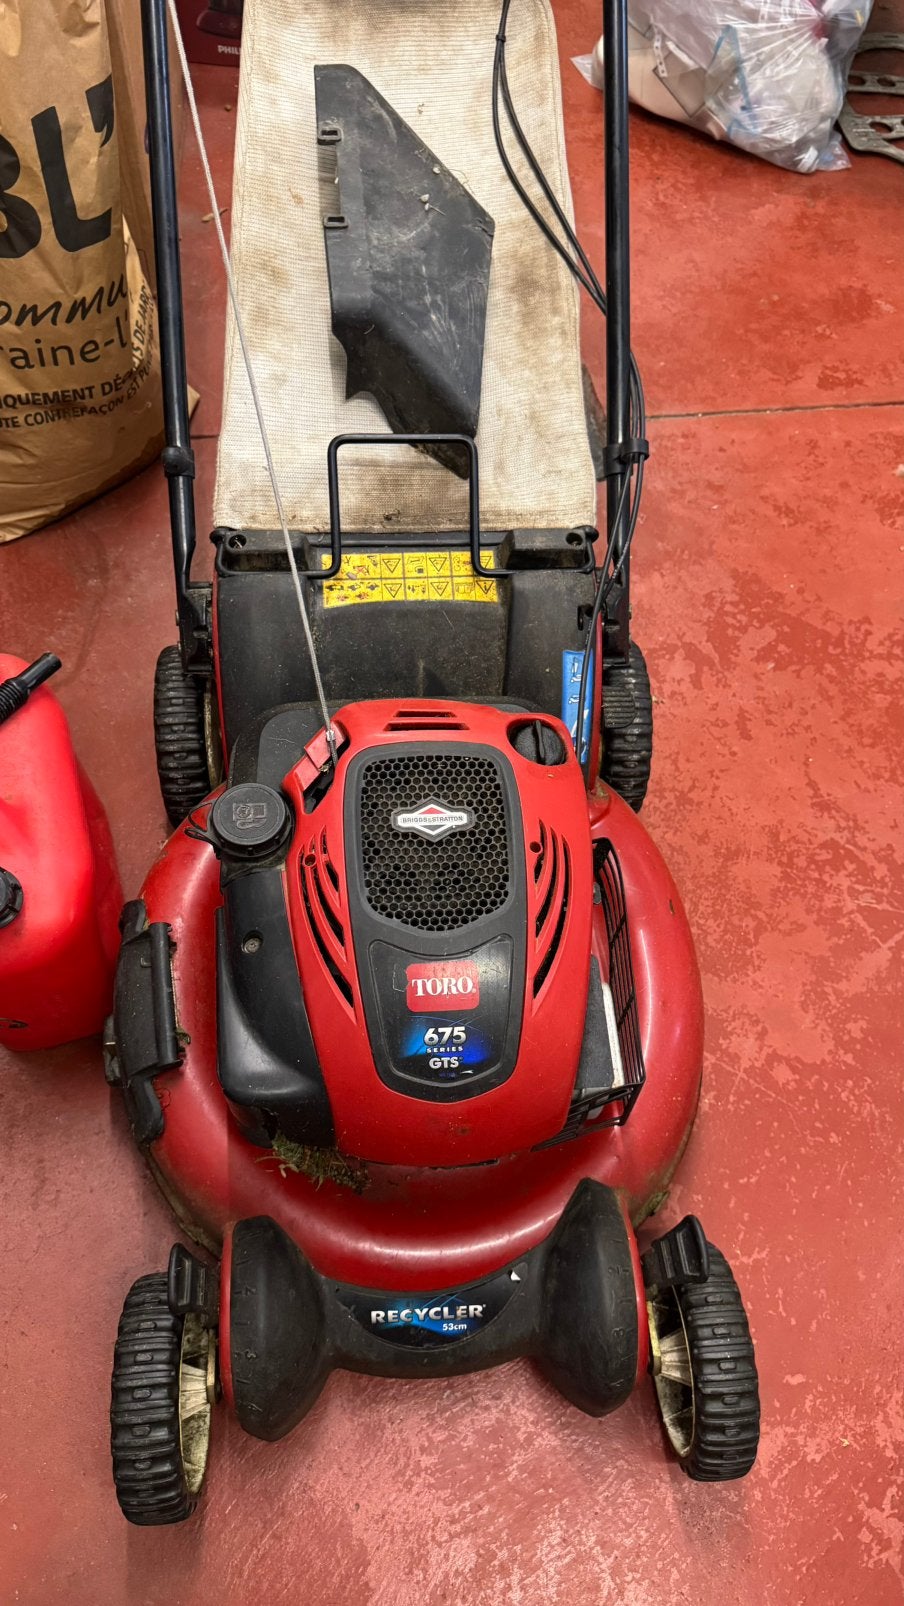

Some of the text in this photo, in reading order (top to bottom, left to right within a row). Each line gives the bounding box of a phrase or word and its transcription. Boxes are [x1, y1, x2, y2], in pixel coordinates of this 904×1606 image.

[0, 309, 128, 370] aine-l'
[0, 416, 21, 428] TE
[411, 976, 473, 997] TORO
[424, 1026, 467, 1046] 675
[428, 1056, 460, 1069] GTS
[370, 1304, 483, 1324] RECYCLER
[442, 1323, 467, 1331] 53cm
